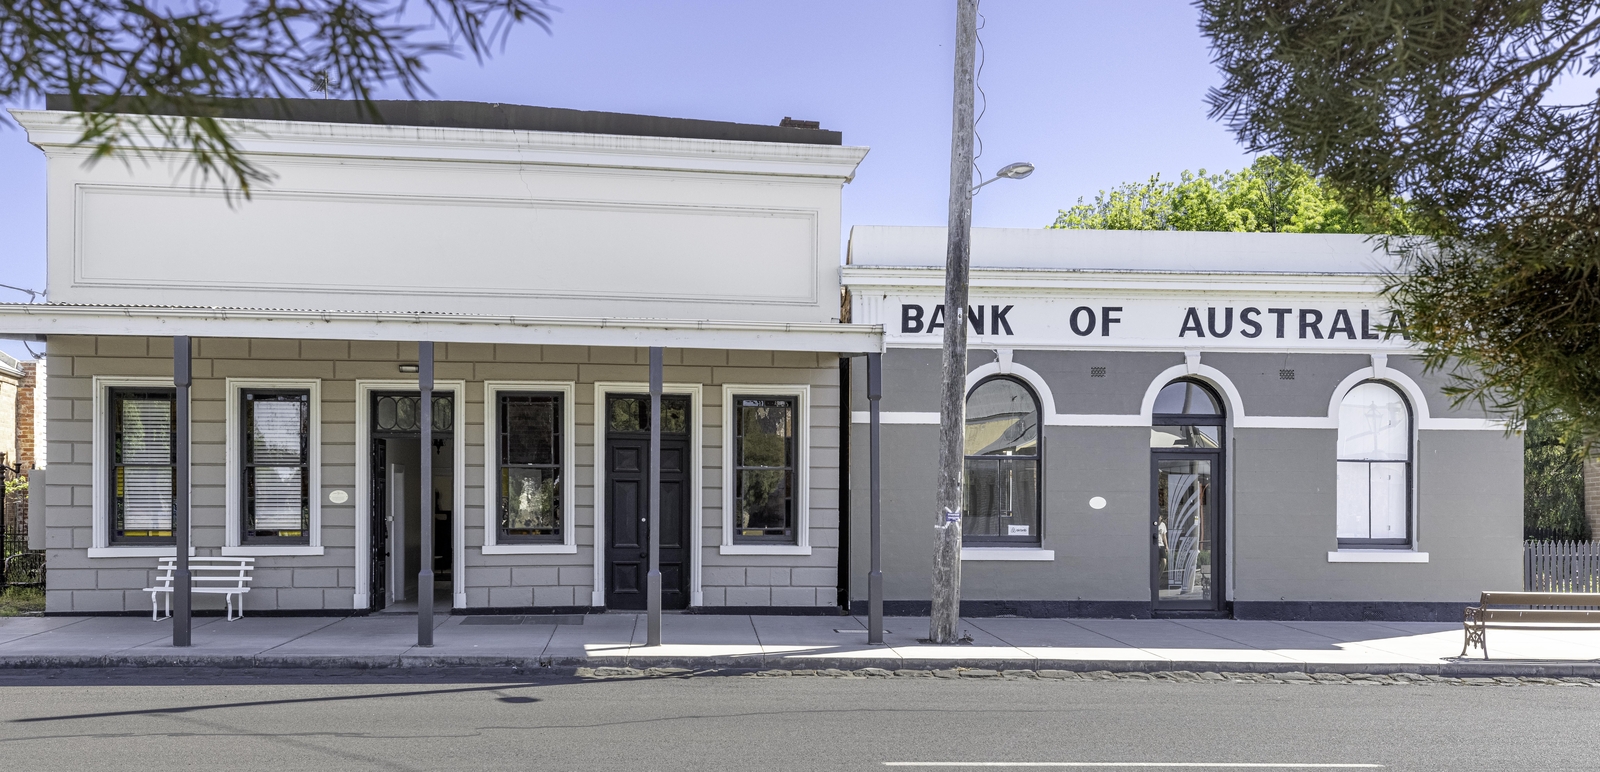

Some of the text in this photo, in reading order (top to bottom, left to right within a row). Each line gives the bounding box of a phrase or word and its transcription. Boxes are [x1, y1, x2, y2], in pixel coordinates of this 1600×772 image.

[901, 304, 1413, 341] BANK OF AUSTRALA
